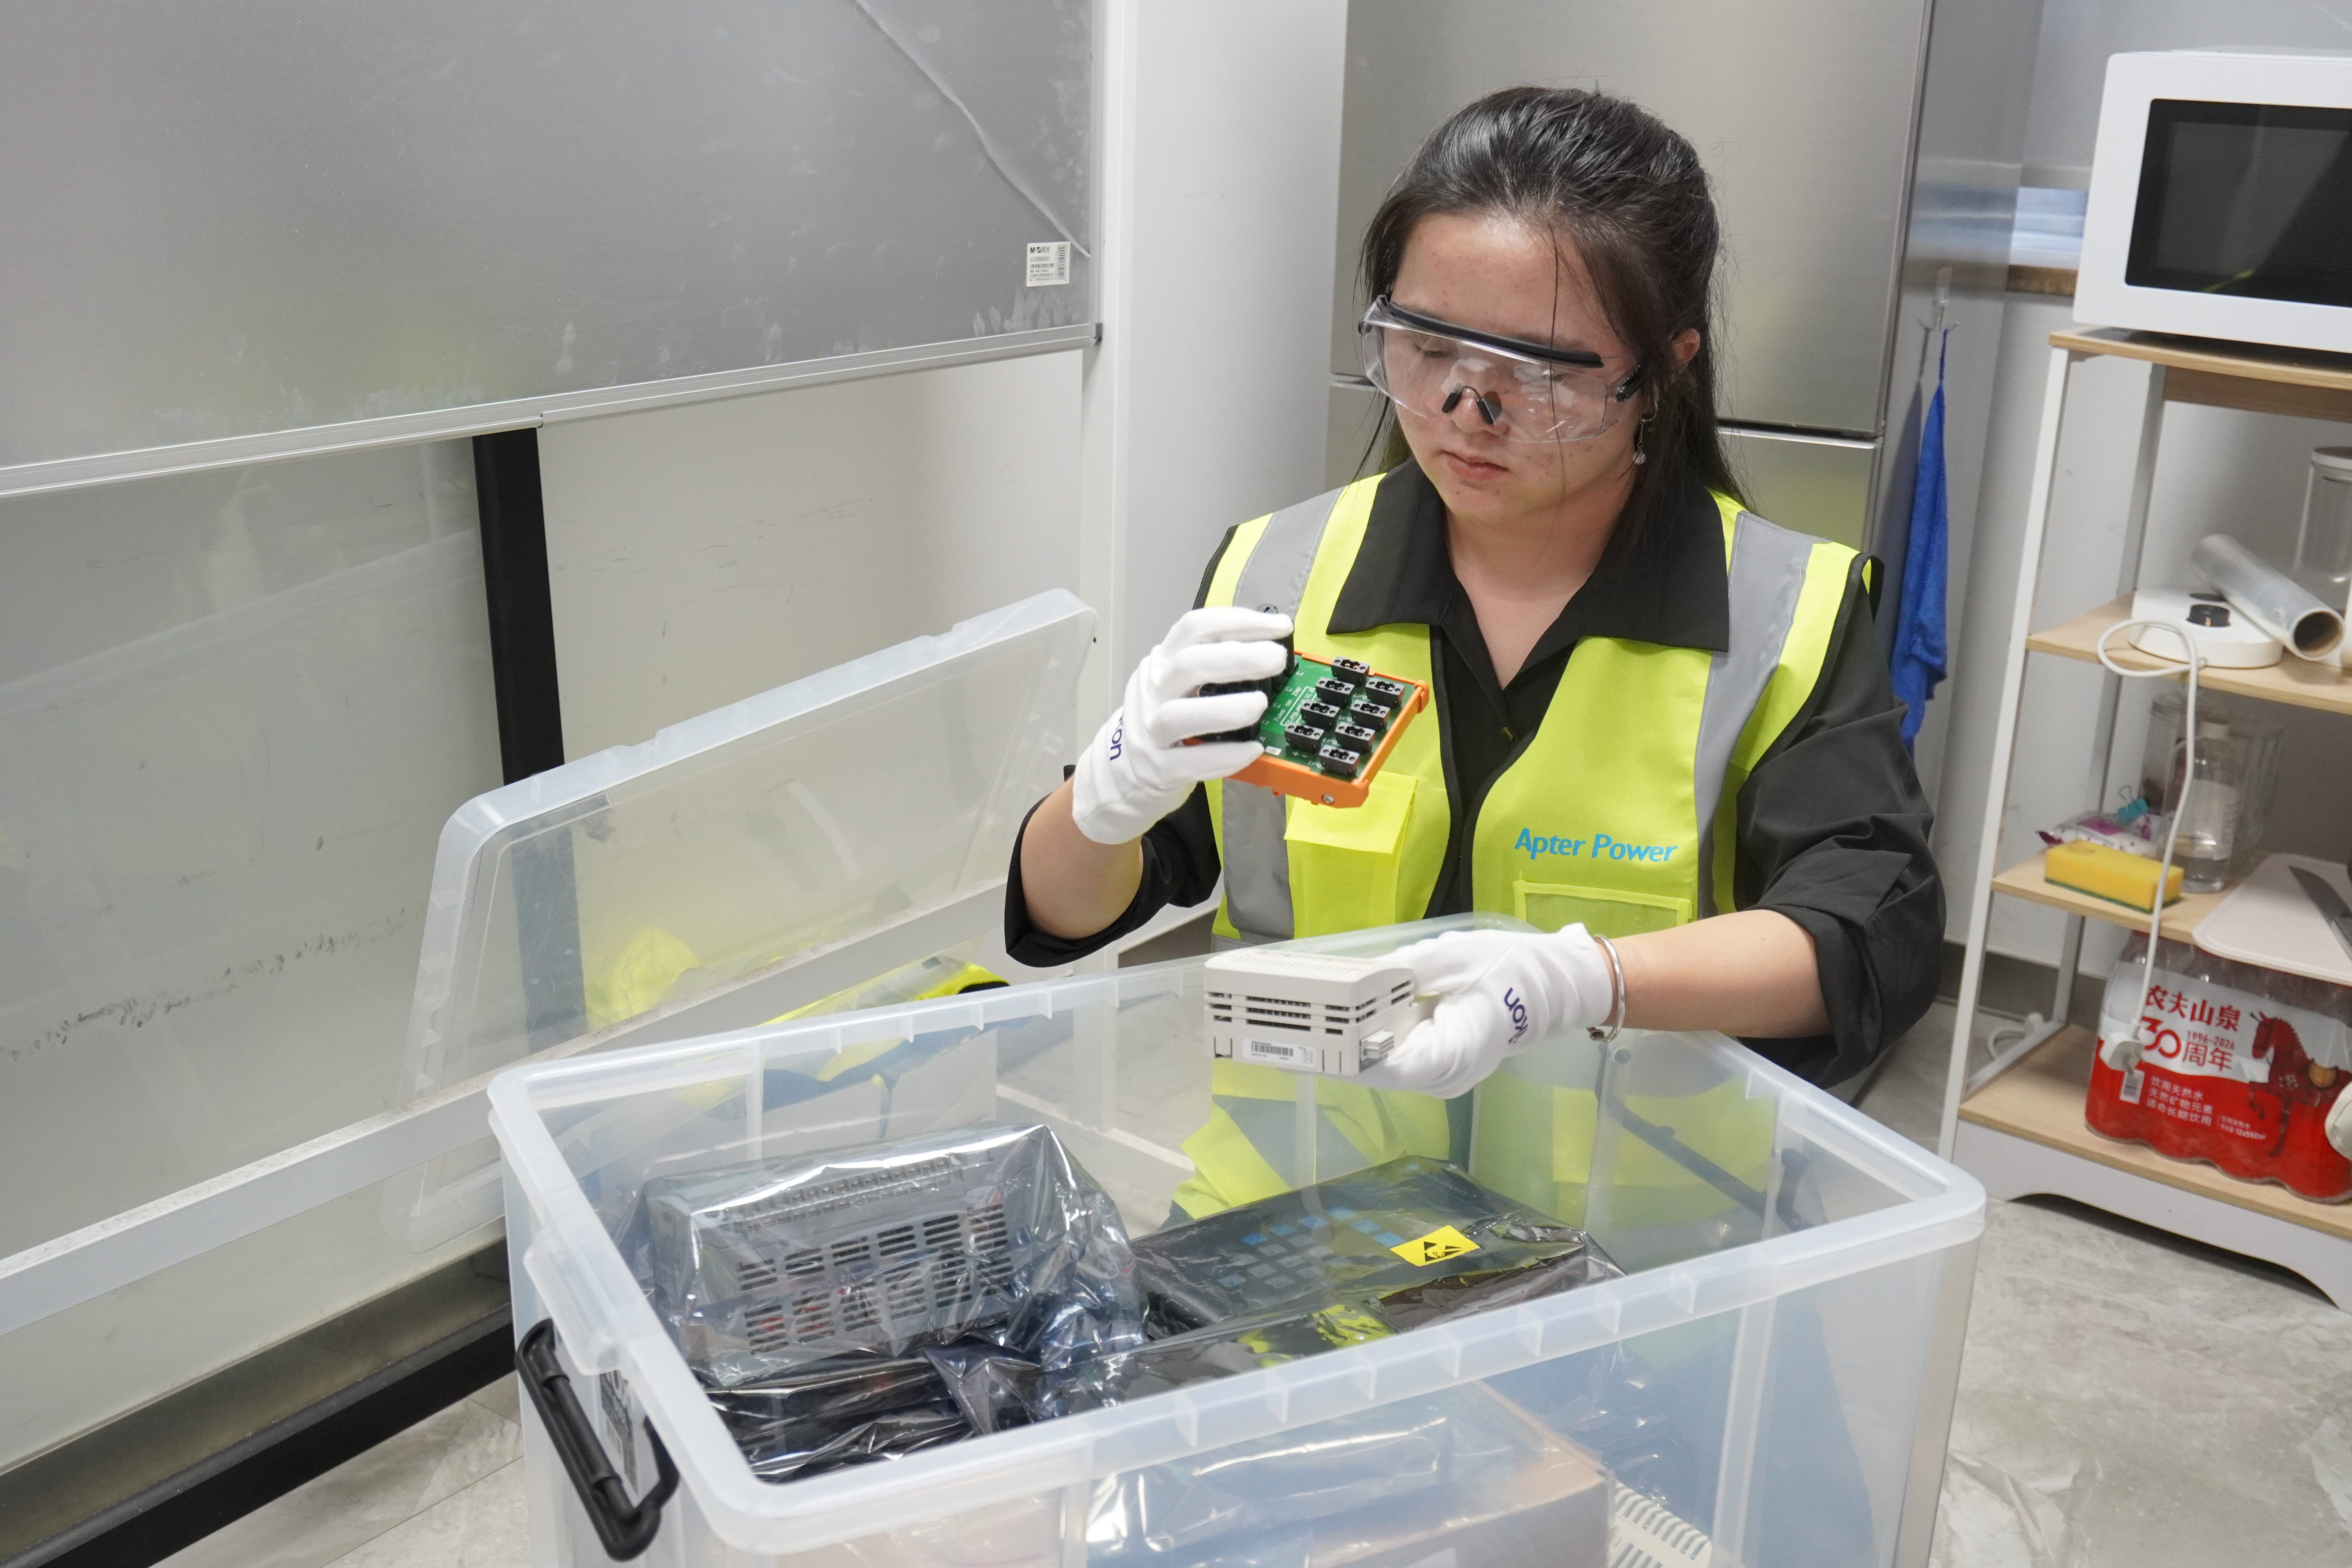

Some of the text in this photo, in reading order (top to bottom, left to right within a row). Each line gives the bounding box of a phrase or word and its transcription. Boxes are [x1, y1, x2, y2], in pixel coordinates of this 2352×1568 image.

[1515, 828, 1678, 862] Apter Power
[2145, 985, 2241, 1032] 农夫山泉
[2141, 1016, 2233, 1071] 30 周年
